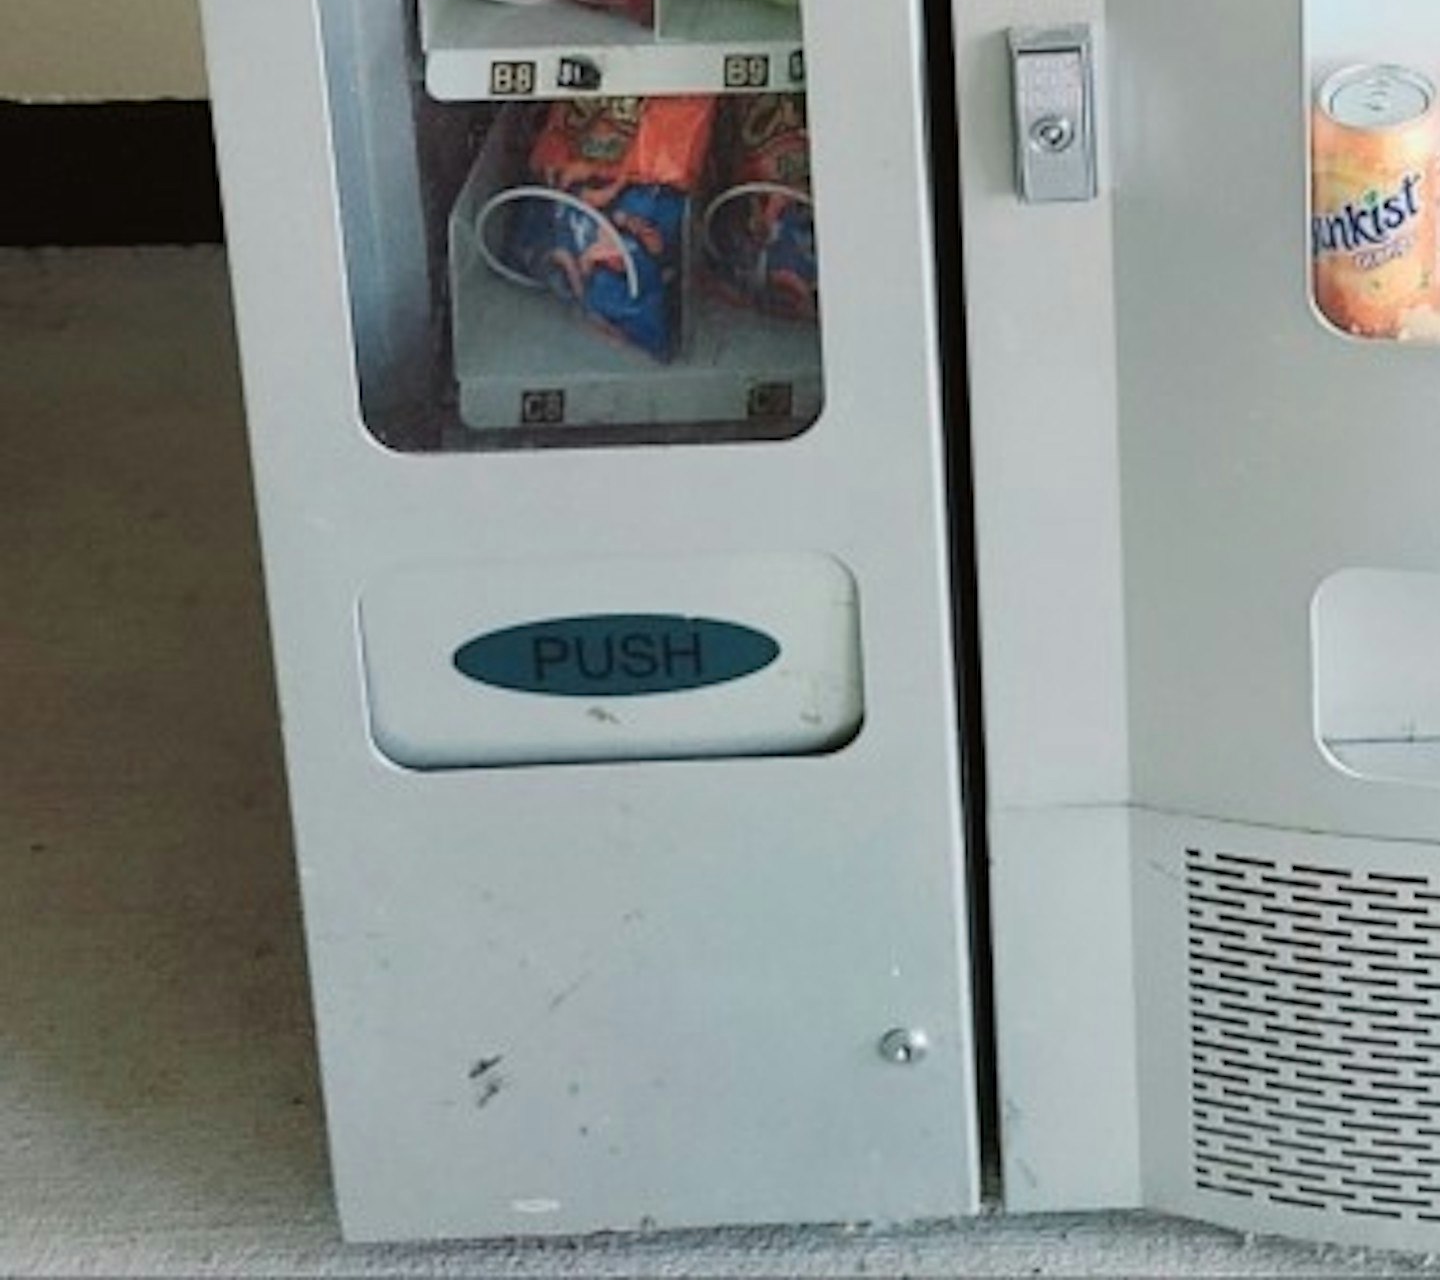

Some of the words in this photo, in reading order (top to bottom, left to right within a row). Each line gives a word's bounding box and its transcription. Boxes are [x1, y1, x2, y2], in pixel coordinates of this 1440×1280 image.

[493, 64, 533, 93] B8
[726, 57, 767, 87] B9
[532, 632, 704, 682] PUSH
